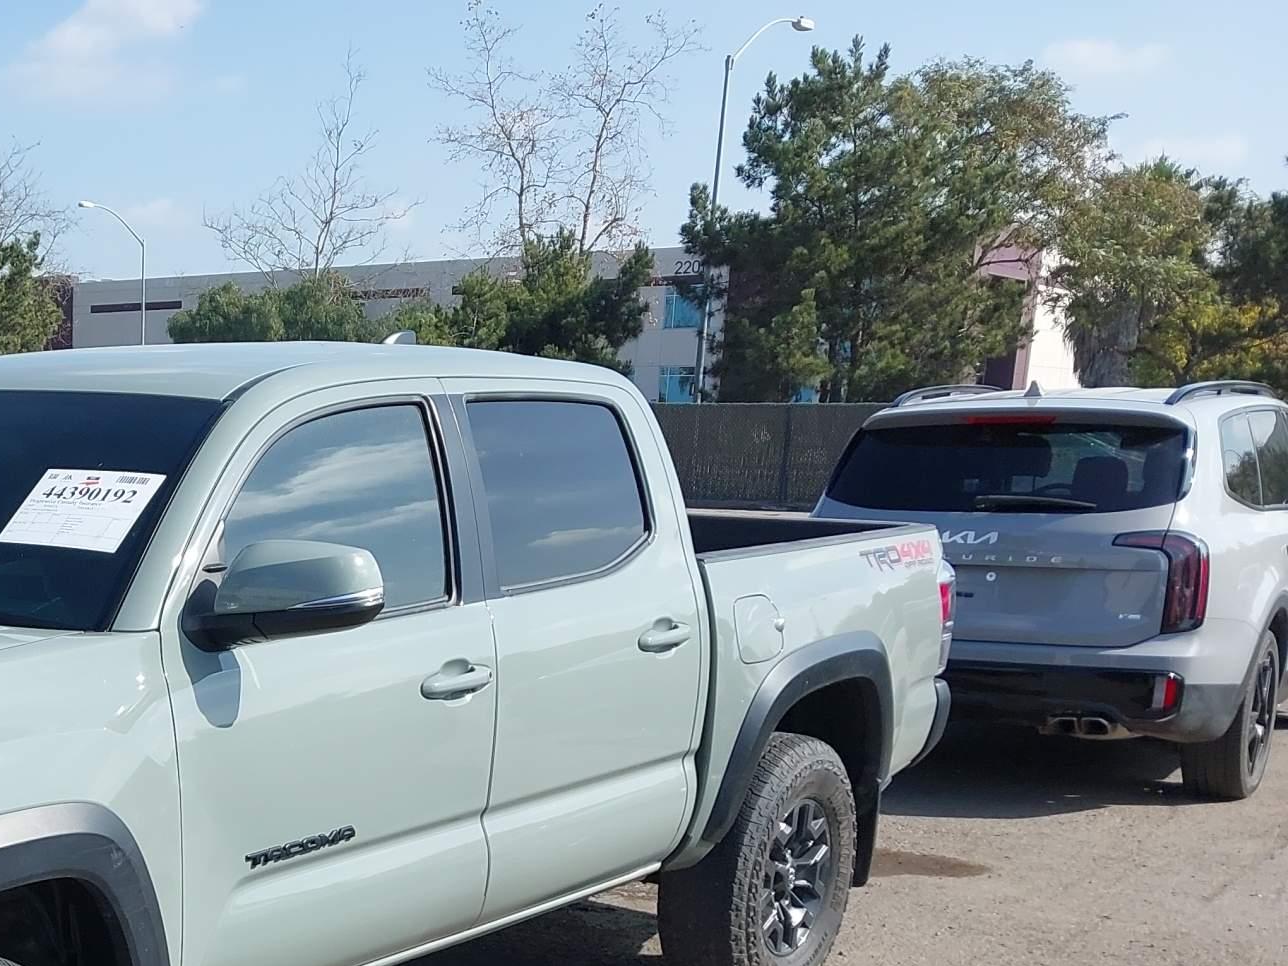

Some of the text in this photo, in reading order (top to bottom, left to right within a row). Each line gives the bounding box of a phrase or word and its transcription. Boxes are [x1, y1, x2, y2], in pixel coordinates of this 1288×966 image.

[42, 485, 138, 504] 44390192
[941, 530, 999, 545] KIA
[943, 553, 1063, 563] LURIDE
[244, 824, 356, 870] TACOMA
